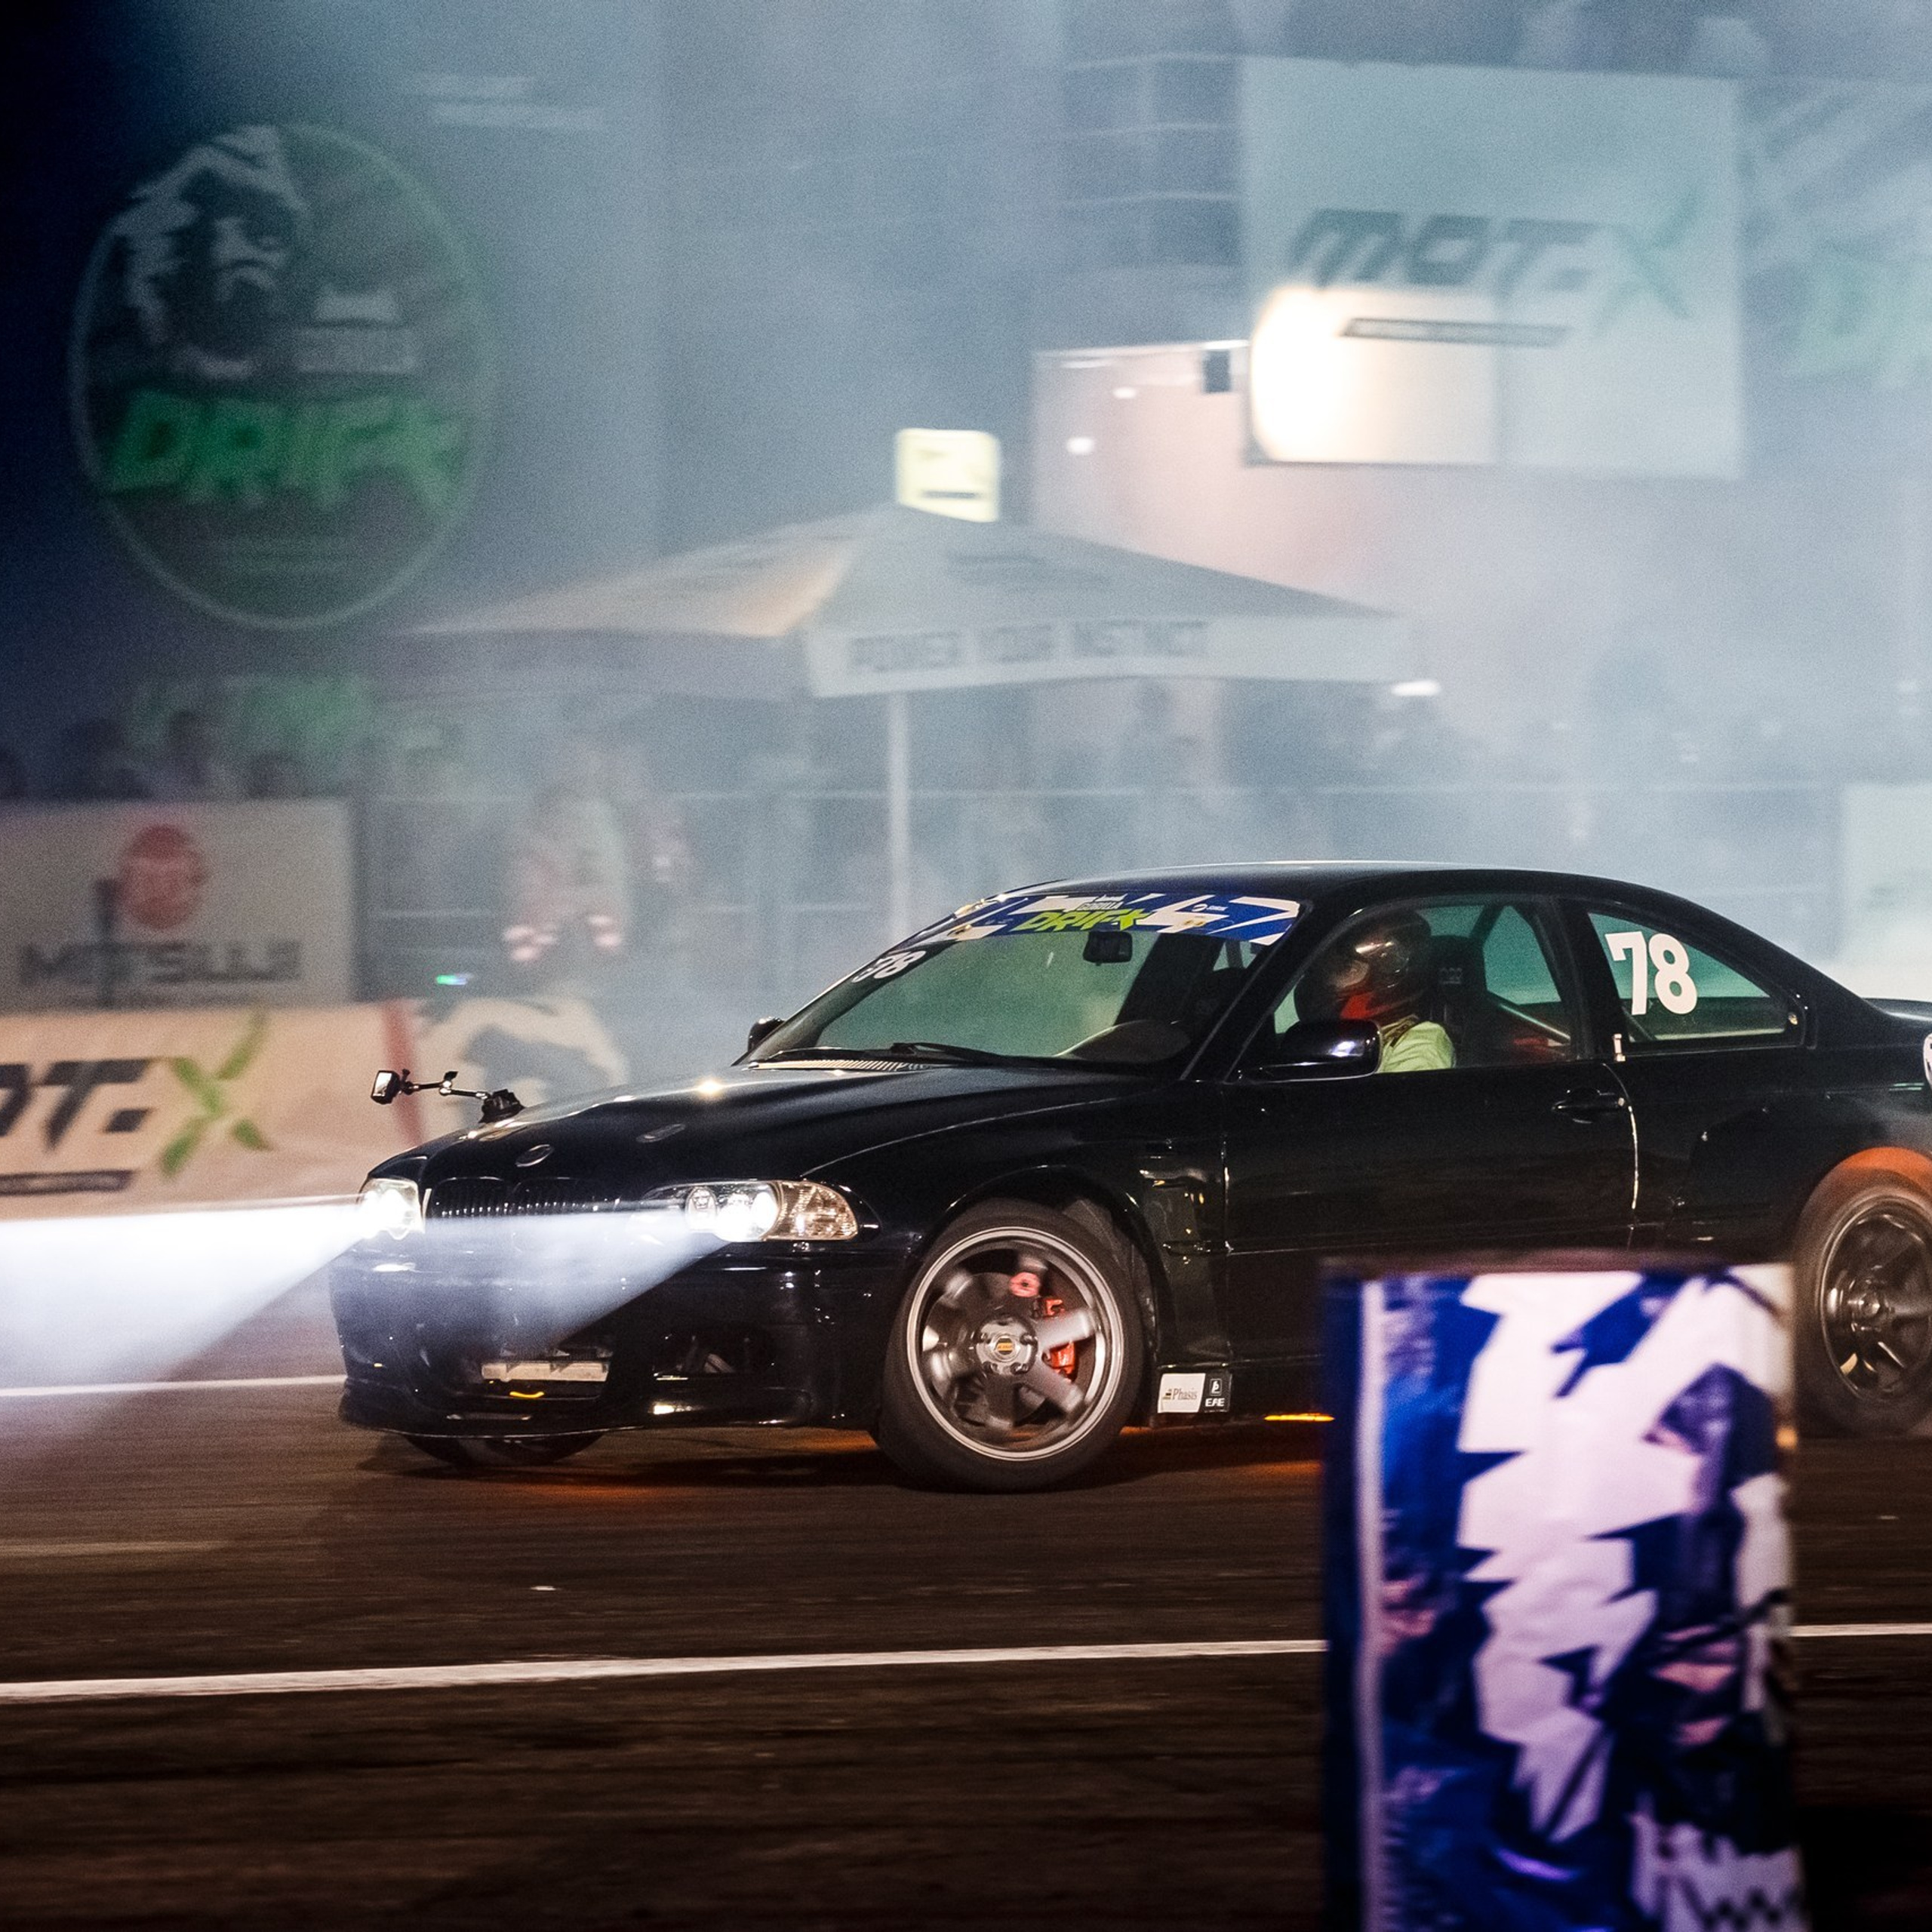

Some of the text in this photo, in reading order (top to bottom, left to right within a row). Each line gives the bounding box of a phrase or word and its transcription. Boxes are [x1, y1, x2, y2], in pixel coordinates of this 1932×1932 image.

[1010, 909, 1153, 931] DRIFT
[1605, 931, 1698, 1015] 78
[1172, 1387, 1198, 1401] Phasis
